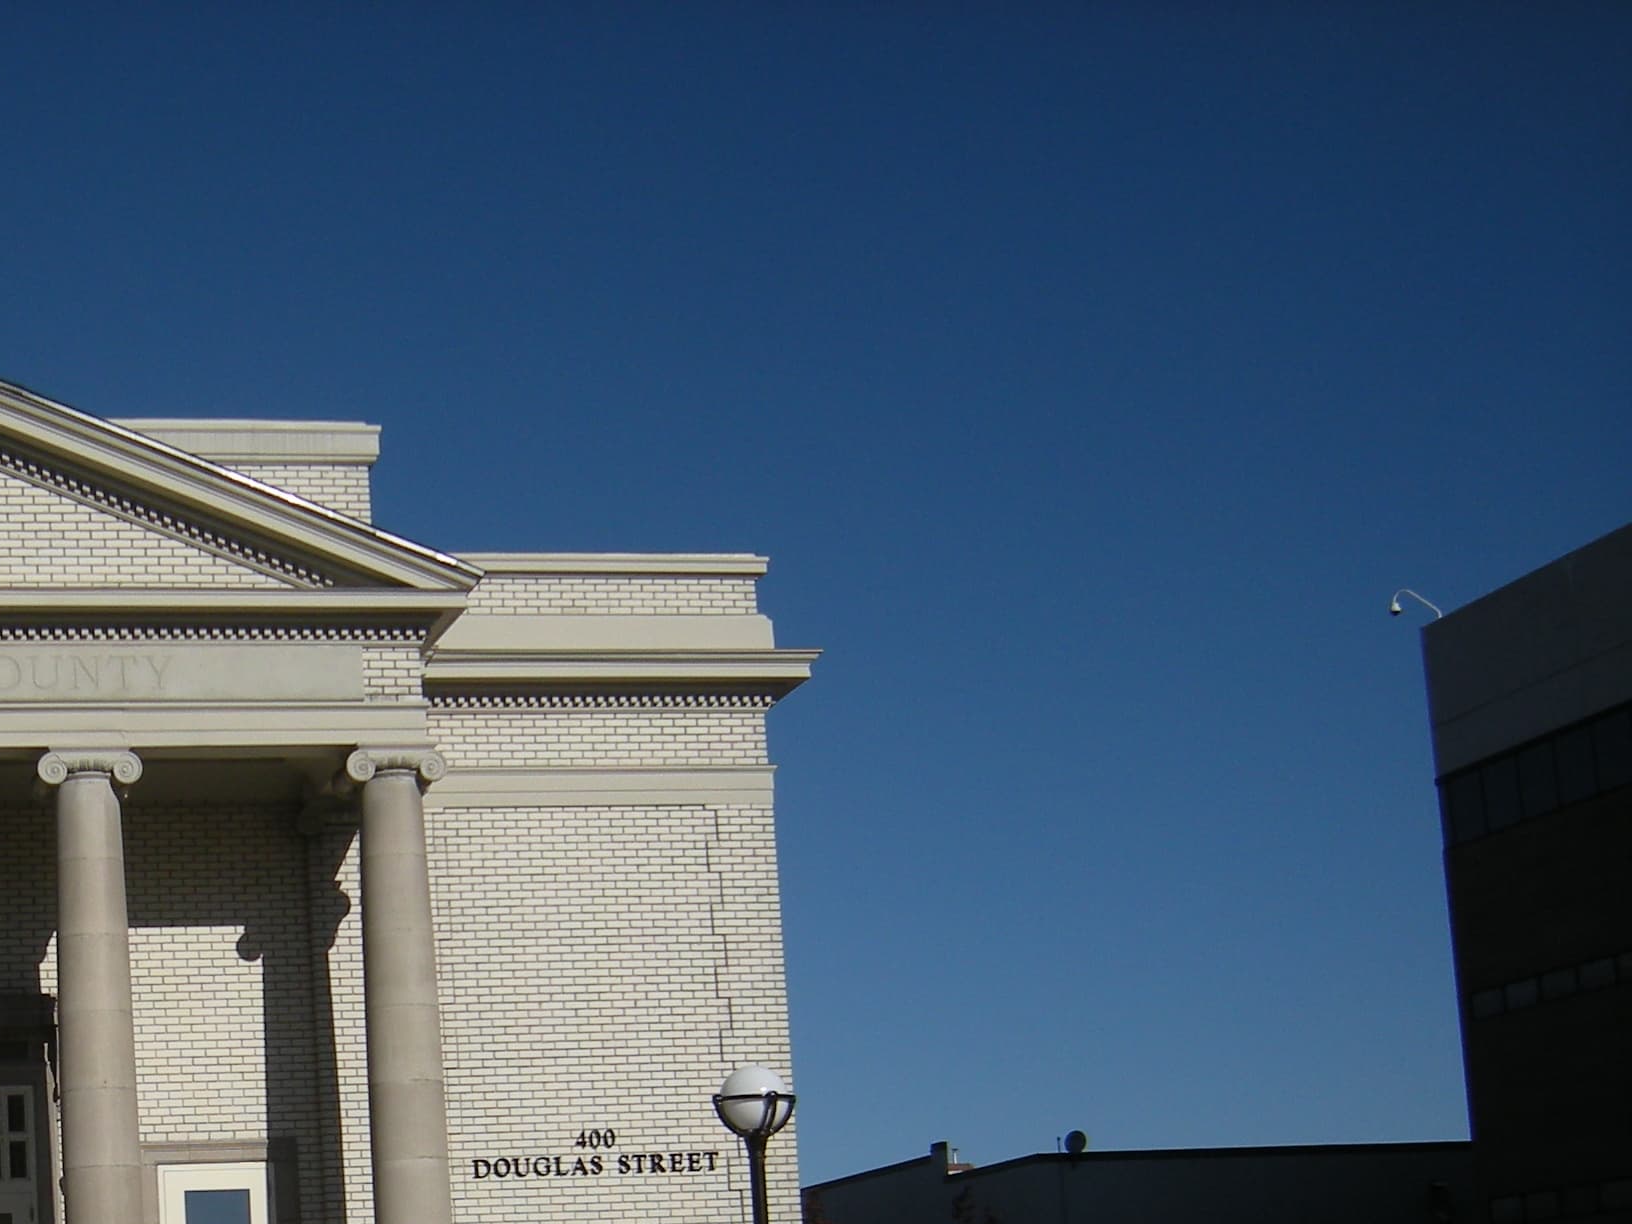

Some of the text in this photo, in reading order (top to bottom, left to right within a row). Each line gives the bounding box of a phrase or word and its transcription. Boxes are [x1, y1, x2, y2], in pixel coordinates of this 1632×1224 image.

[575, 1128, 616, 1149] 400
[472, 1151, 719, 1179] DOUGLAS STREET
